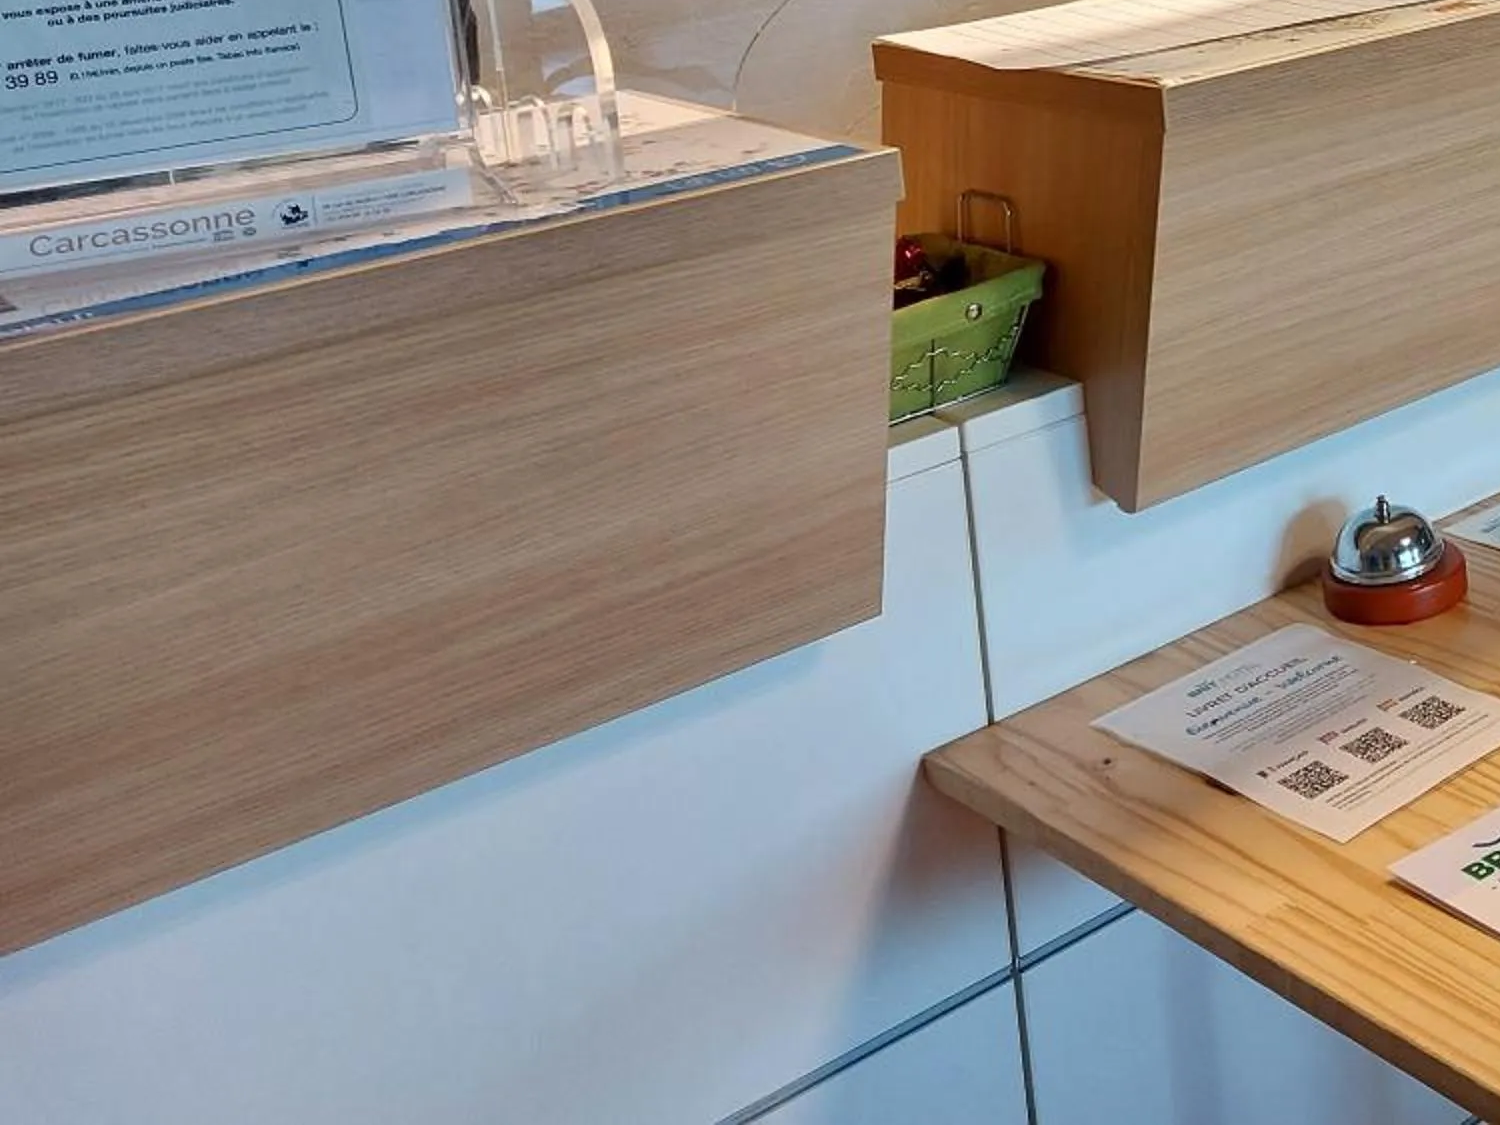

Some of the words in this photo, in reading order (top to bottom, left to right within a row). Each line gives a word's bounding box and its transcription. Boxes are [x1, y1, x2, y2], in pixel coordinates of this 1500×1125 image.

[36, 4, 80, 15] expose
[84, 0, 93, 10] à
[96, 0, 118, 8] une
[47, 18, 63, 27] ou
[67, 15, 75, 25] à
[78, 13, 100, 23] des
[103, 4, 168, 21] poursuites
[8, 57, 52, 70] arrêter
[56, 54, 74, 64] de
[248, 25, 297, 40] appelant
[5, 74, 29, 90] 39
[34, 70, 59, 86] 89
[28, 204, 256, 258] Carcassonne
